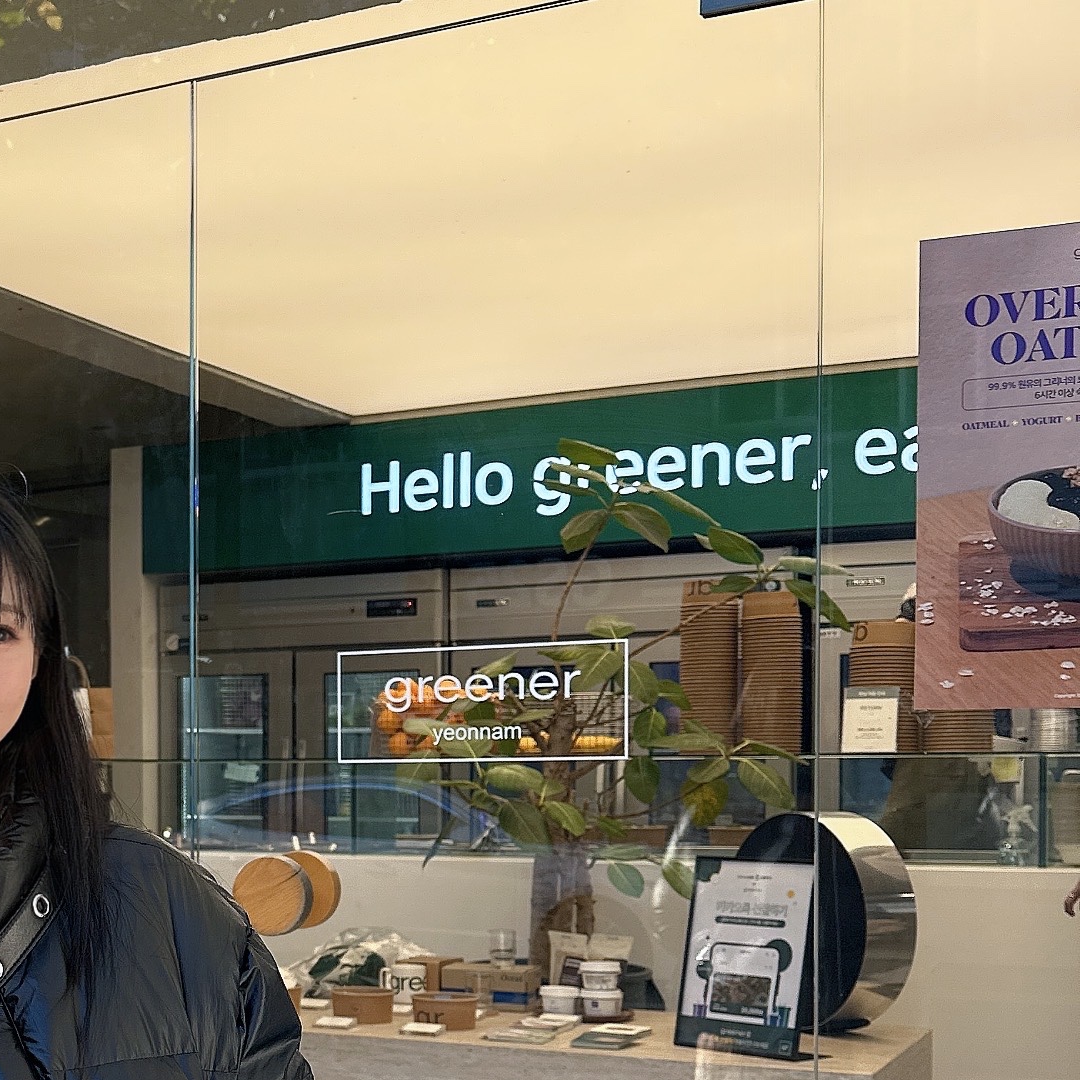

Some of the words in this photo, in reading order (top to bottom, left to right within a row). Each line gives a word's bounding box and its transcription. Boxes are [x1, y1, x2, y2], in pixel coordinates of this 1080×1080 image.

[988, 381, 1017, 391] 99.9%
[1058, 387, 1075, 397] 이상
[962, 419, 1010, 431] OATMEAL
[1021, 415, 1063, 426] YOGURT
[360, 450, 514, 516] Hello
[384, 668, 581, 713] greener
[432, 725, 522, 746] yeonnam
